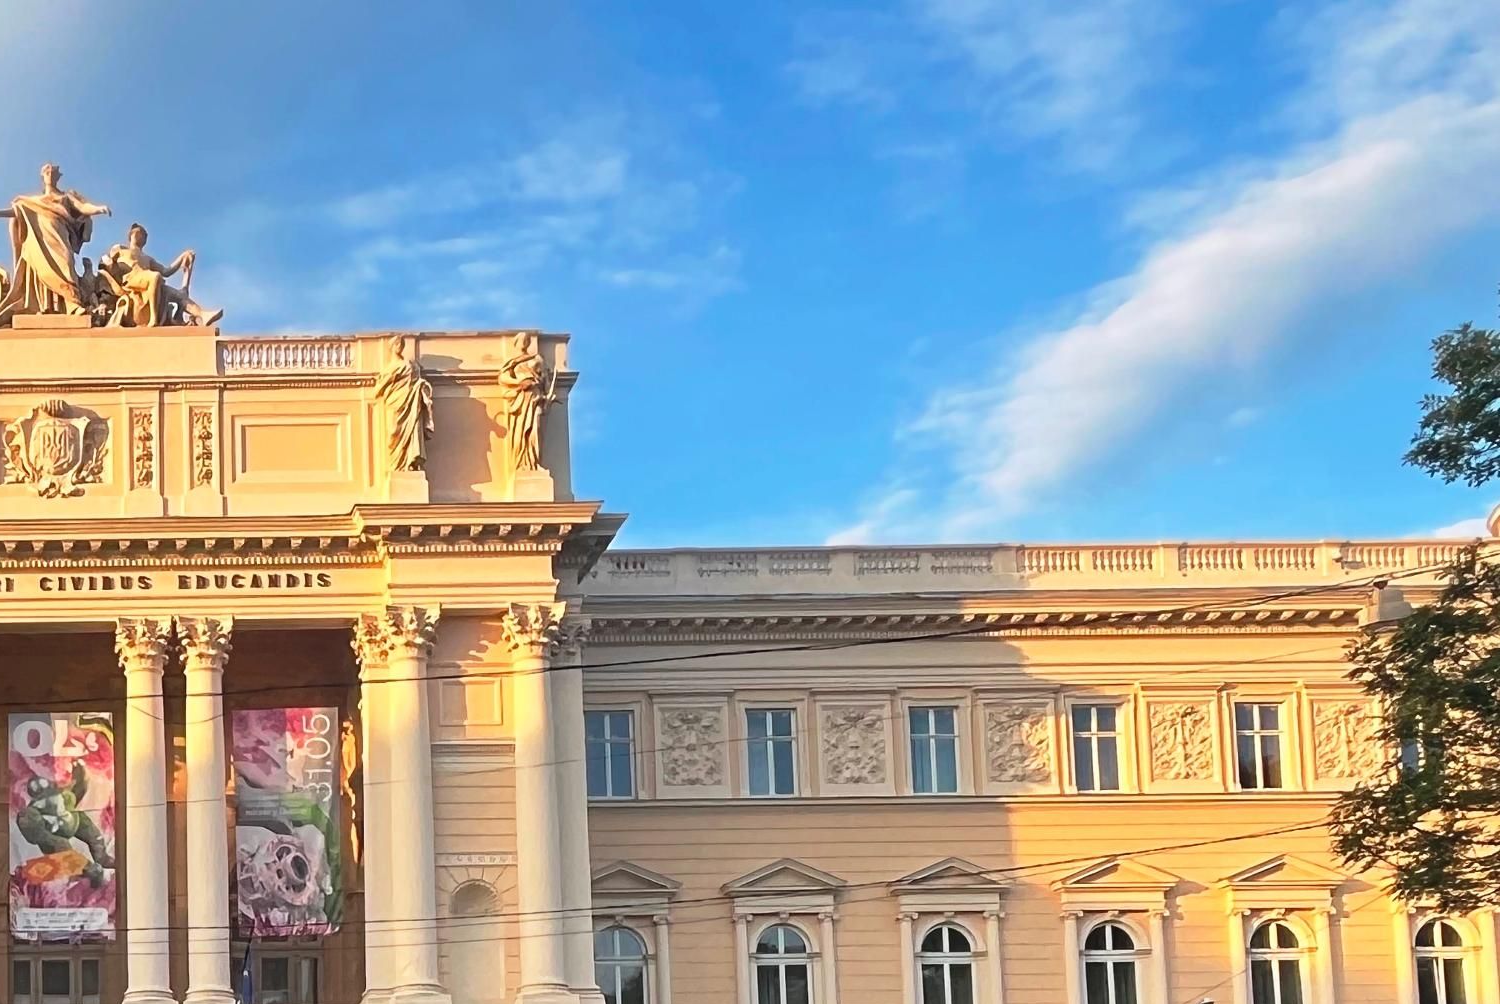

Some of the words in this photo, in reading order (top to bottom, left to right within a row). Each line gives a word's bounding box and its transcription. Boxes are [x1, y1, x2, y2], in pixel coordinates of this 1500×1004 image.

[39, 575, 153, 592] CIVIBUS
[177, 573, 332, 590] EDUCANDIS
[302, 713, 333, 802] 31.05
